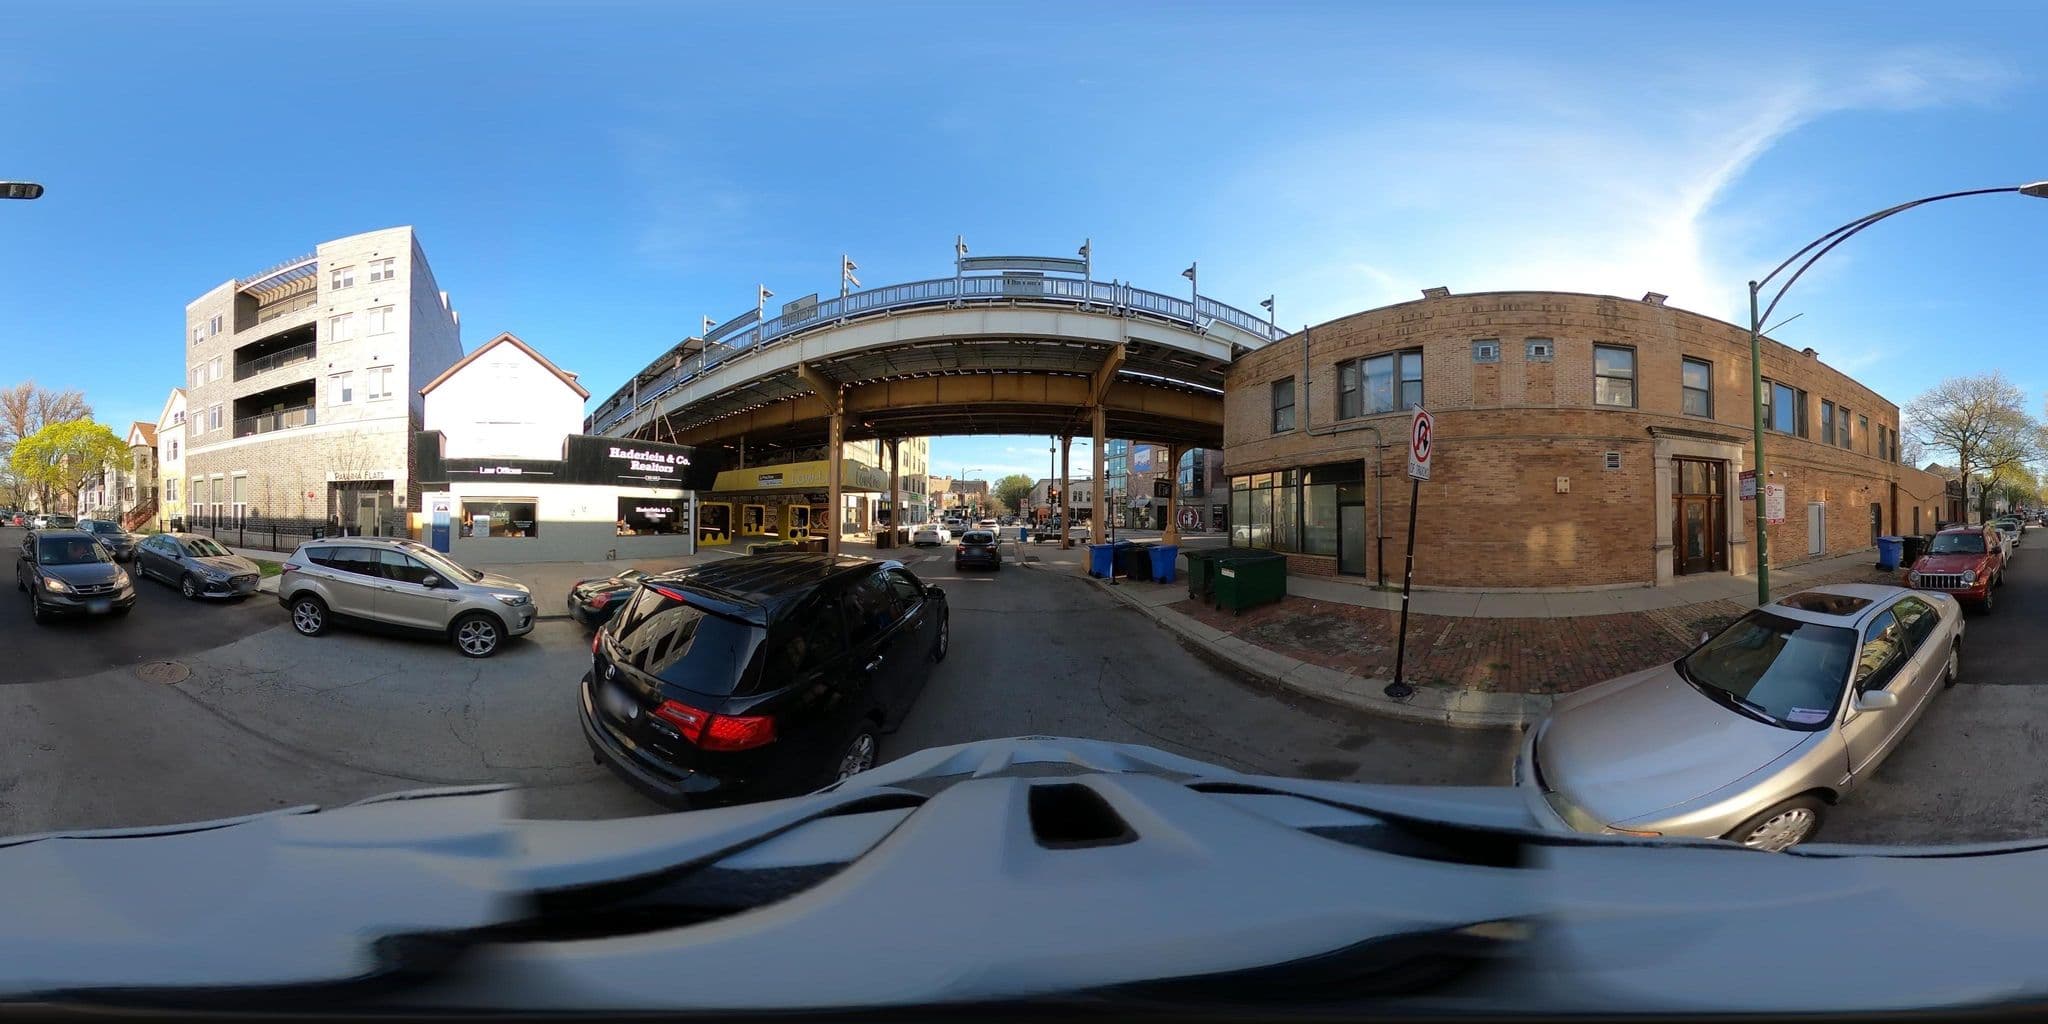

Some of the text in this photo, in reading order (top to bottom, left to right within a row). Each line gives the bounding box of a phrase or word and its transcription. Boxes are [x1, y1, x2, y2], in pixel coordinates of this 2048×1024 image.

[609, 447, 690, 465] Haderlein & Co.
[630, 460, 674, 473] Realtors
